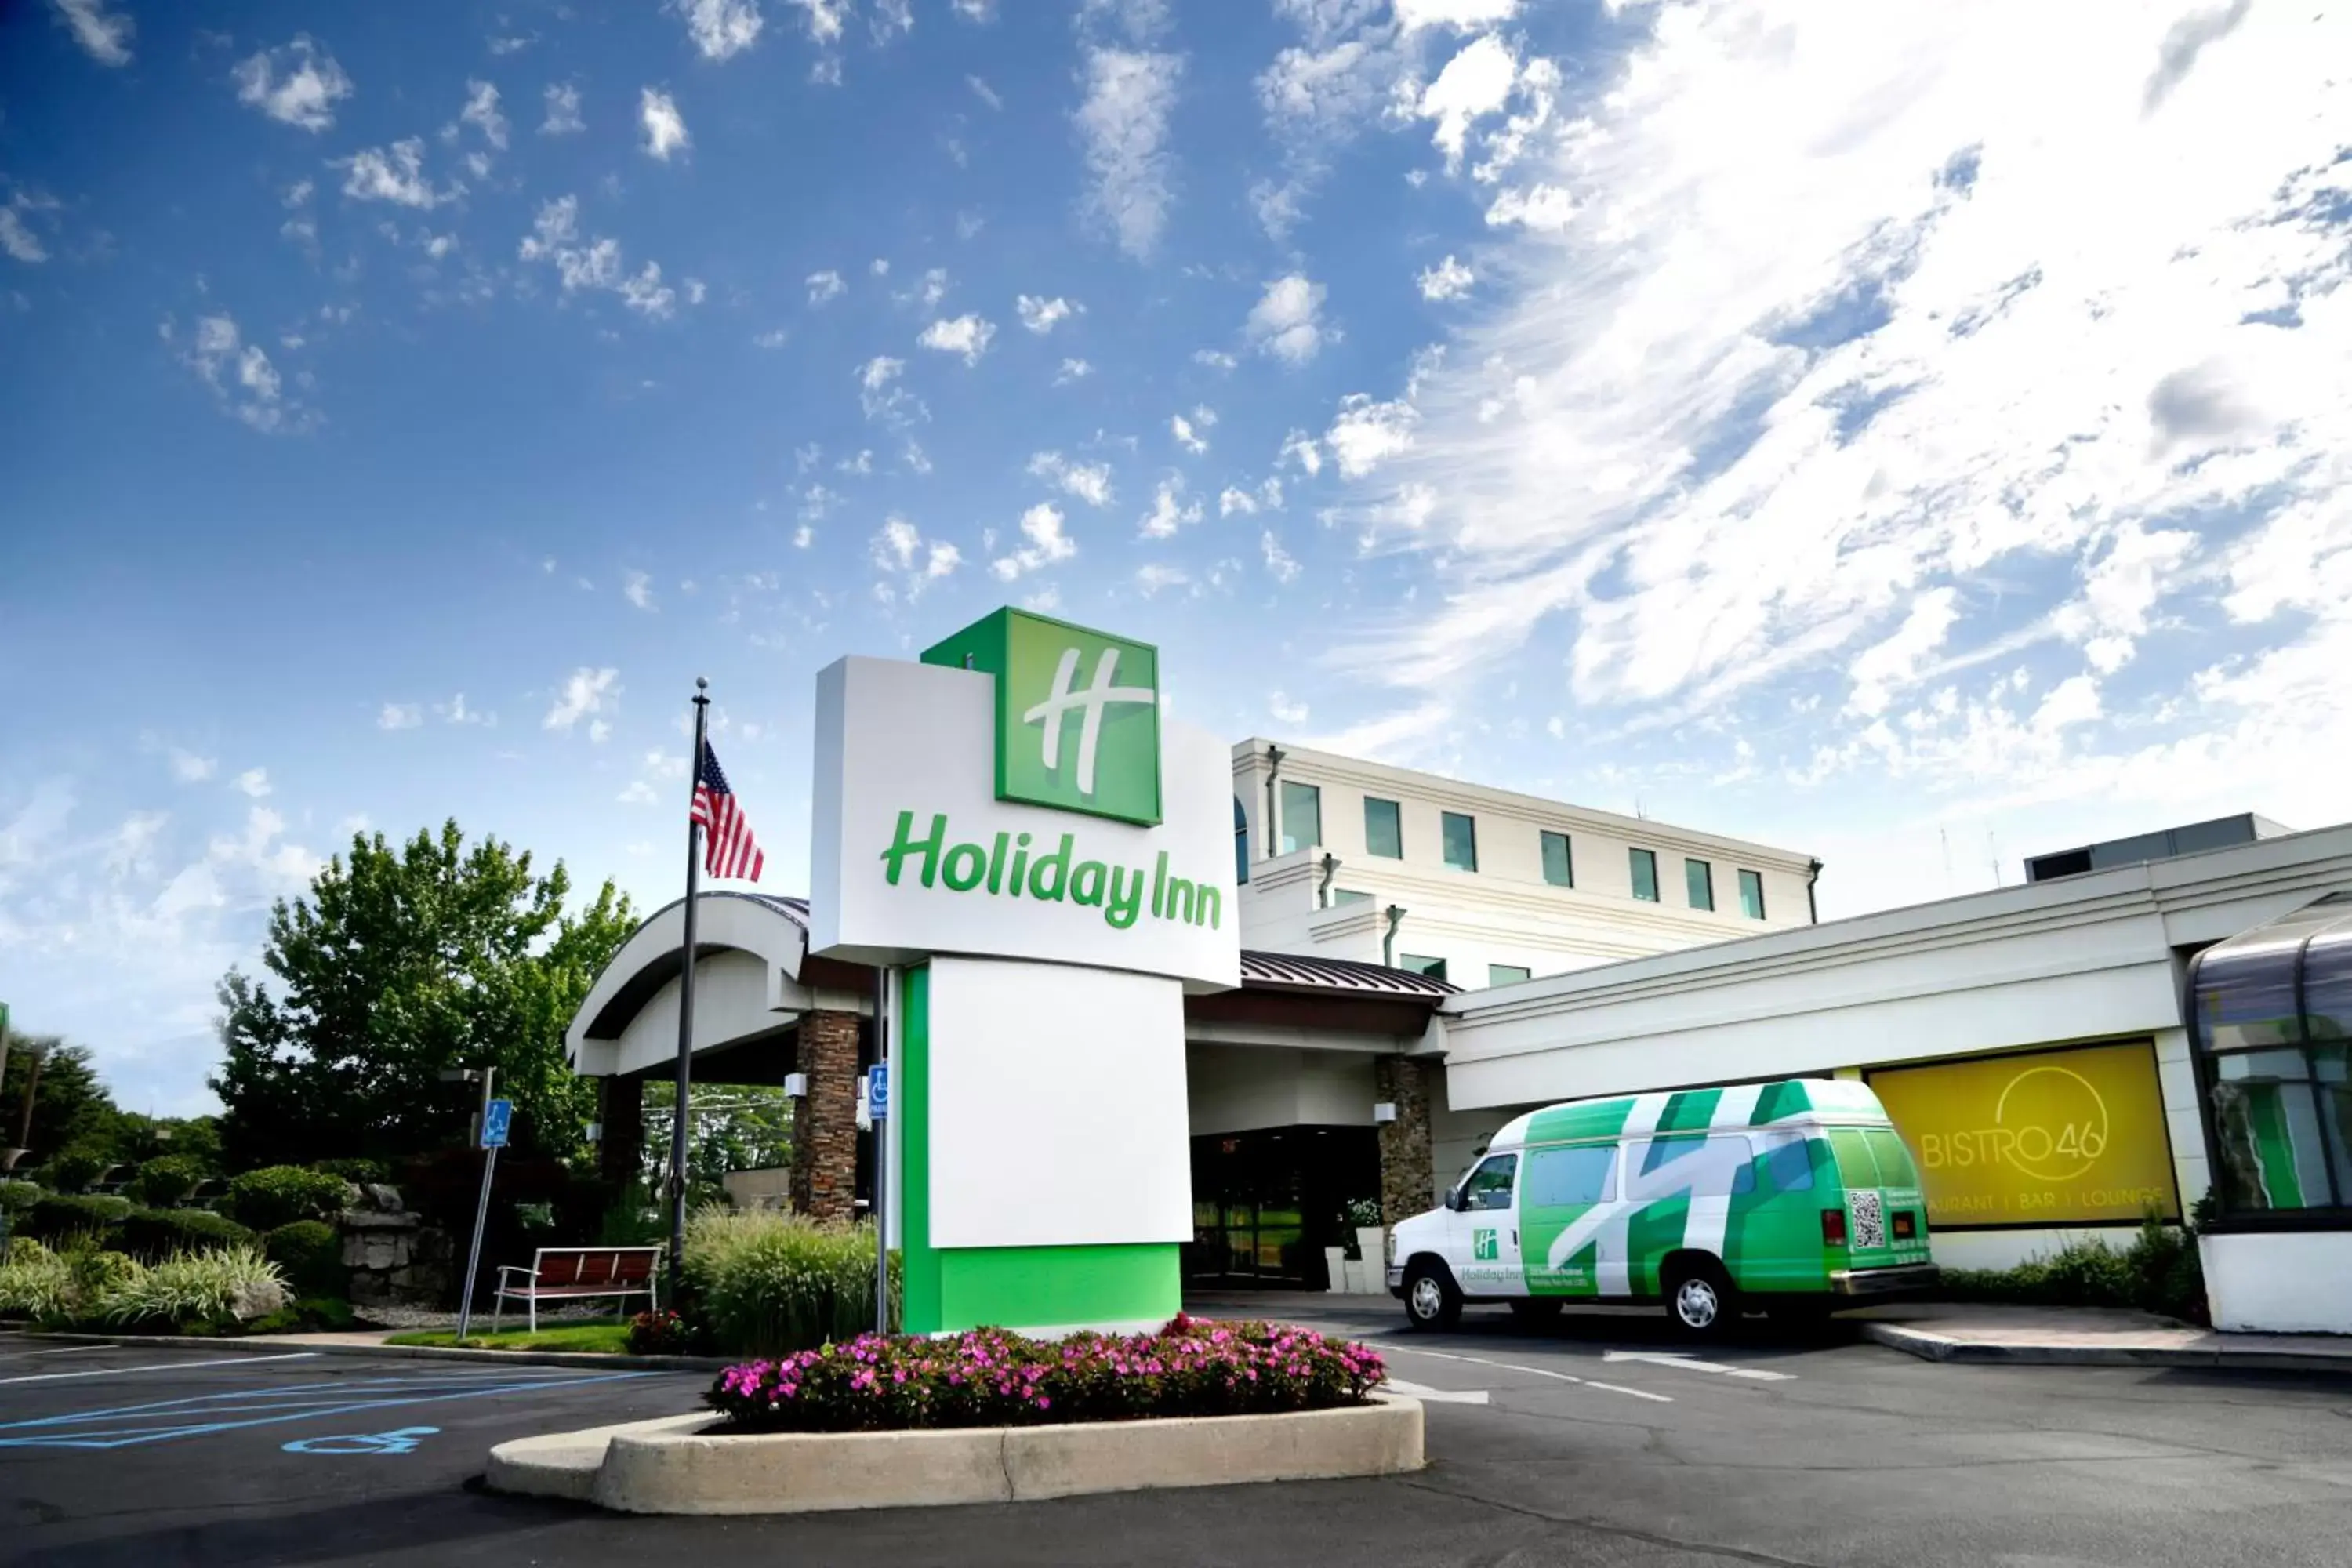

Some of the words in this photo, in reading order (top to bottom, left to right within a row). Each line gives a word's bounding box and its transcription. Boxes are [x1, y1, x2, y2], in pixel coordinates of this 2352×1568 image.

[1023, 648, 1155, 795] H
[880, 810, 1145, 930] Holiday
[1151, 850, 1221, 931] Inn
[1928, 1193, 1994, 1214] AURANT
[2018, 1191, 2056, 1210] BAR
[2082, 1186, 2164, 1207] LOUNGE
[1461, 1266, 1504, 1283] Holiday
[1505, 1266, 1525, 1280] Inn
